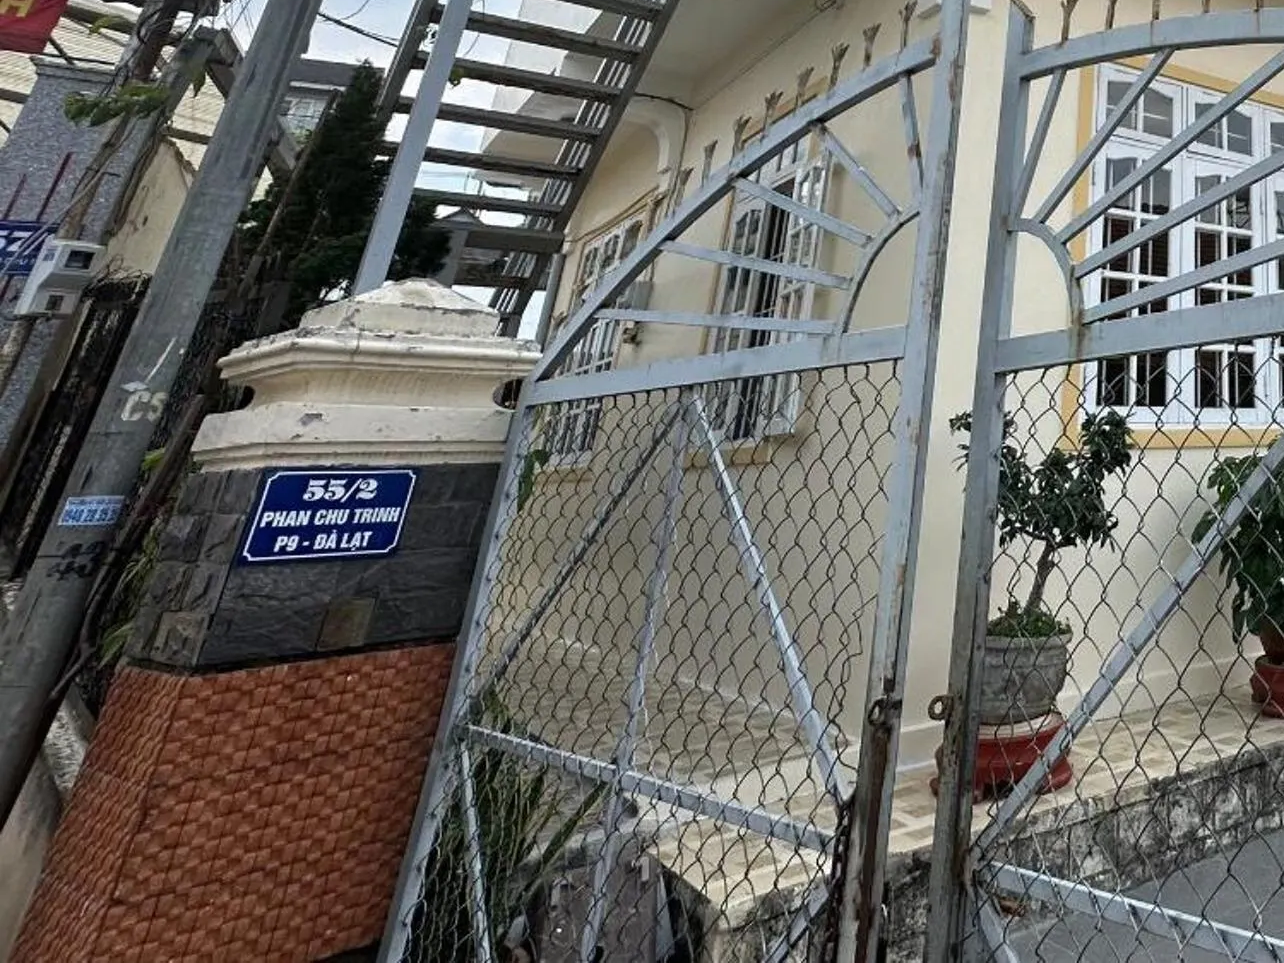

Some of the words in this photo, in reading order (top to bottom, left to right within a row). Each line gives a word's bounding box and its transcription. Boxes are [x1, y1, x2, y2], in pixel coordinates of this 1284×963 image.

[302, 477, 379, 503] 55/2
[260, 510, 312, 528] PHAN
[314, 508, 349, 526] CHU
[352, 507, 401, 524] TRINH
[273, 535, 300, 553] P9
[313, 529, 339, 550] ĐÀ
[340, 531, 373, 551] LẠT
